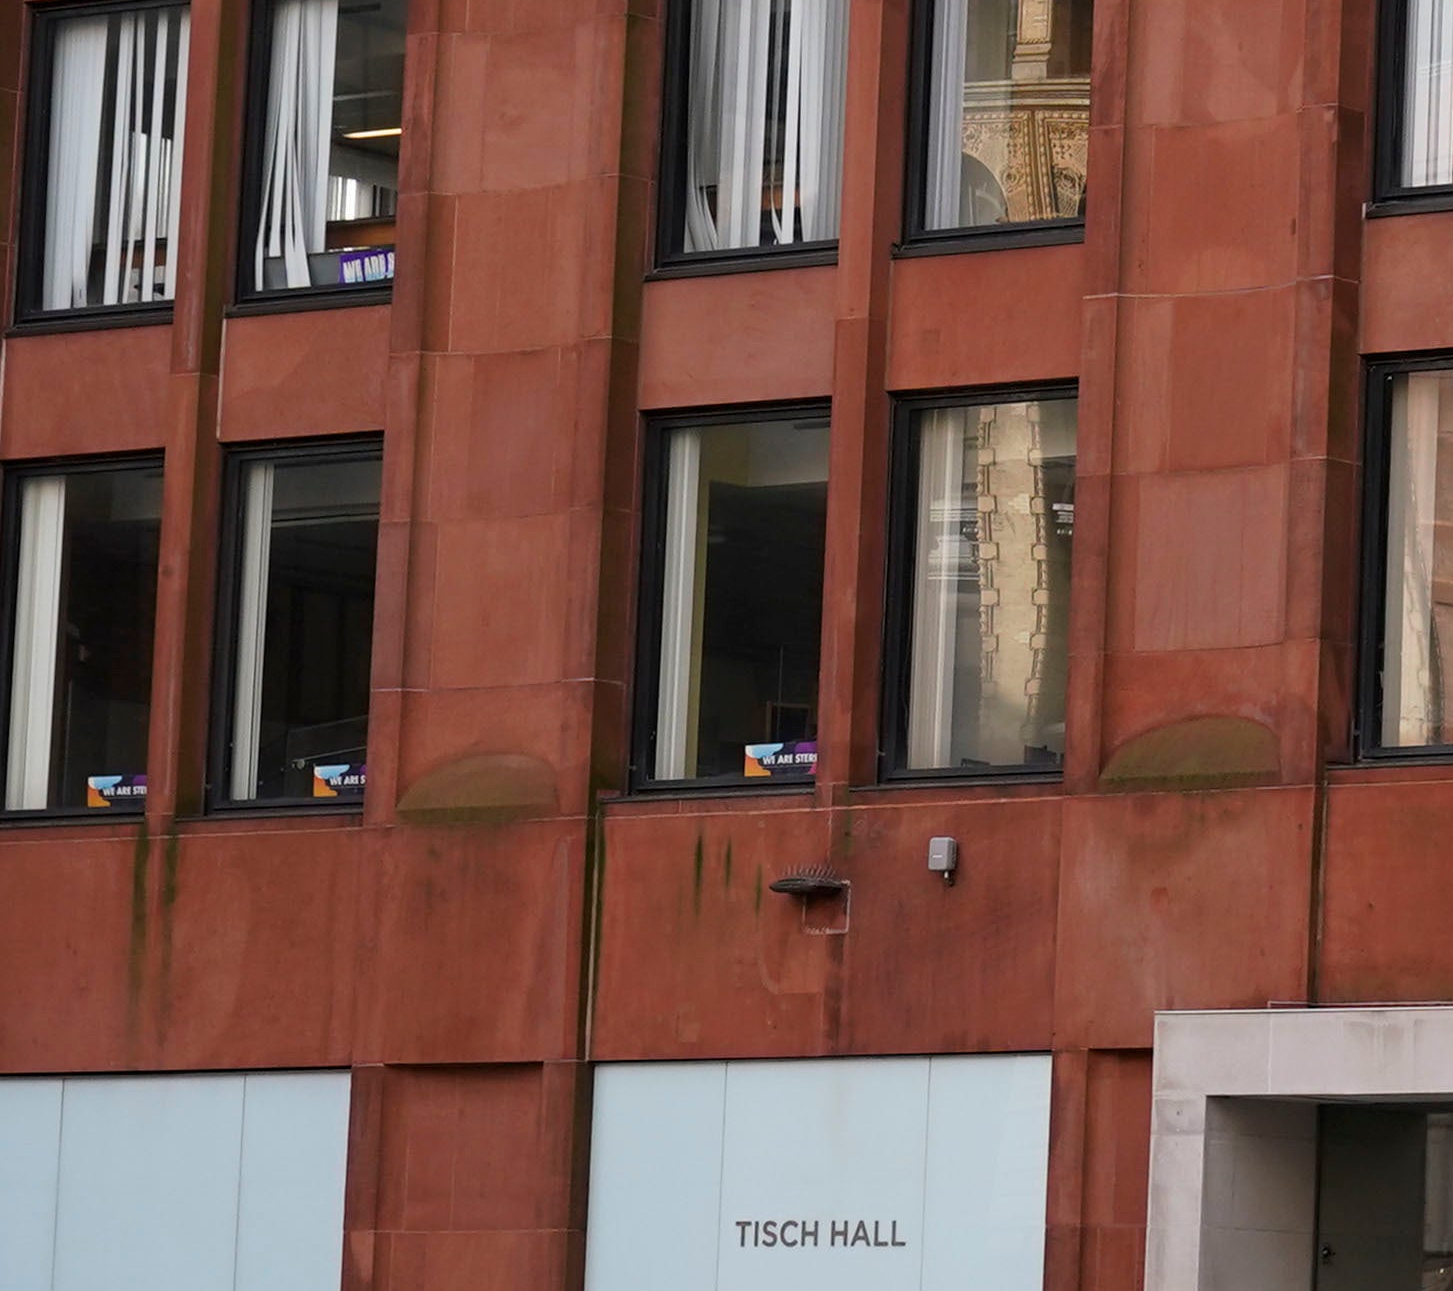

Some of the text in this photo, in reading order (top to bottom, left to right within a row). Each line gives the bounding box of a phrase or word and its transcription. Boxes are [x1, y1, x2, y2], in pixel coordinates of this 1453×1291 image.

[762, 755, 775, 765] WE
[777, 754, 793, 764] ARE
[329, 777, 342, 786] WE
[344, 775, 359, 785] ARE
[103, 787, 115, 796] WE
[117, 786, 131, 795] ARE
[735, 1220, 907, 1247] TISCH HALL
